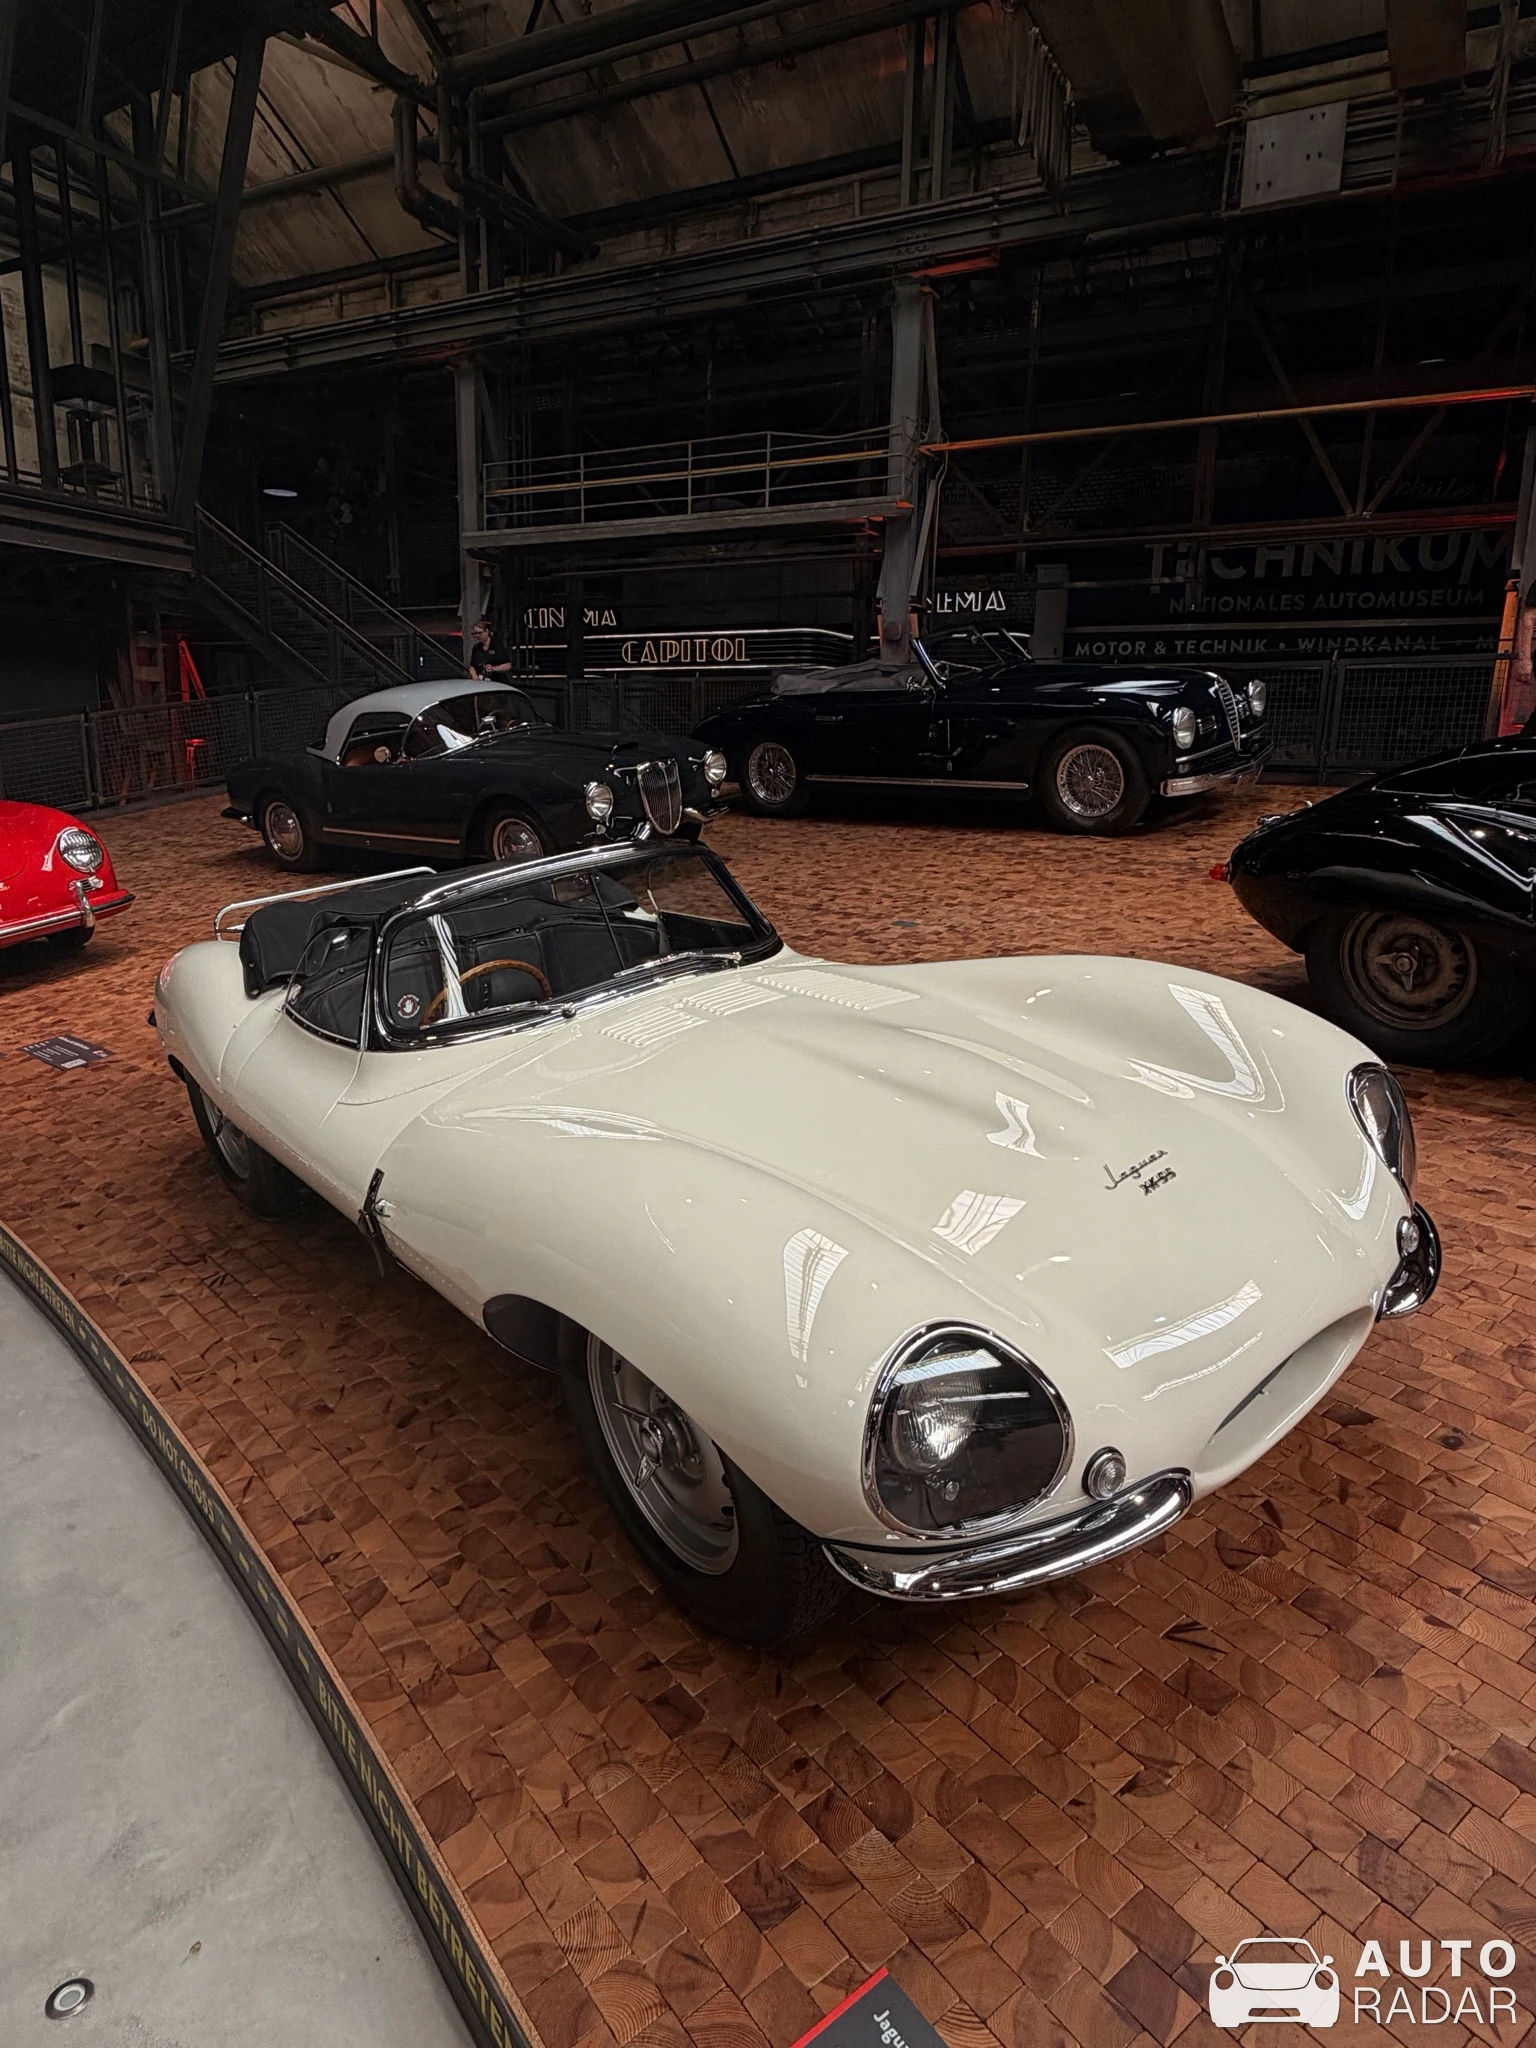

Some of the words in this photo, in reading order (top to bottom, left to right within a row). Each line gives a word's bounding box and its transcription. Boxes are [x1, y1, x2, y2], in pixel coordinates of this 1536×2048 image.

[1169, 593, 1305, 614] NTIONALES
[1312, 588, 1485, 611] AUTOMUSEUM
[622, 638, 751, 664] CAPITOL
[1074, 641, 1147, 657] MOTOR
[1154, 640, 1167, 656] &
[1174, 638, 1268, 655] TECHNIK
[1297, 635, 1441, 653] WINDKANAL
[1103, 1149, 1168, 1190] Jaguar
[142, 1403, 157, 1438] DO
[158, 1426, 178, 1470] NOT
[180, 1459, 215, 1523] CROSS
[318, 1676, 357, 1767] BITTE
[360, 1752, 412, 1868] NICHT
[873, 2009, 909, 2048] Jagu
